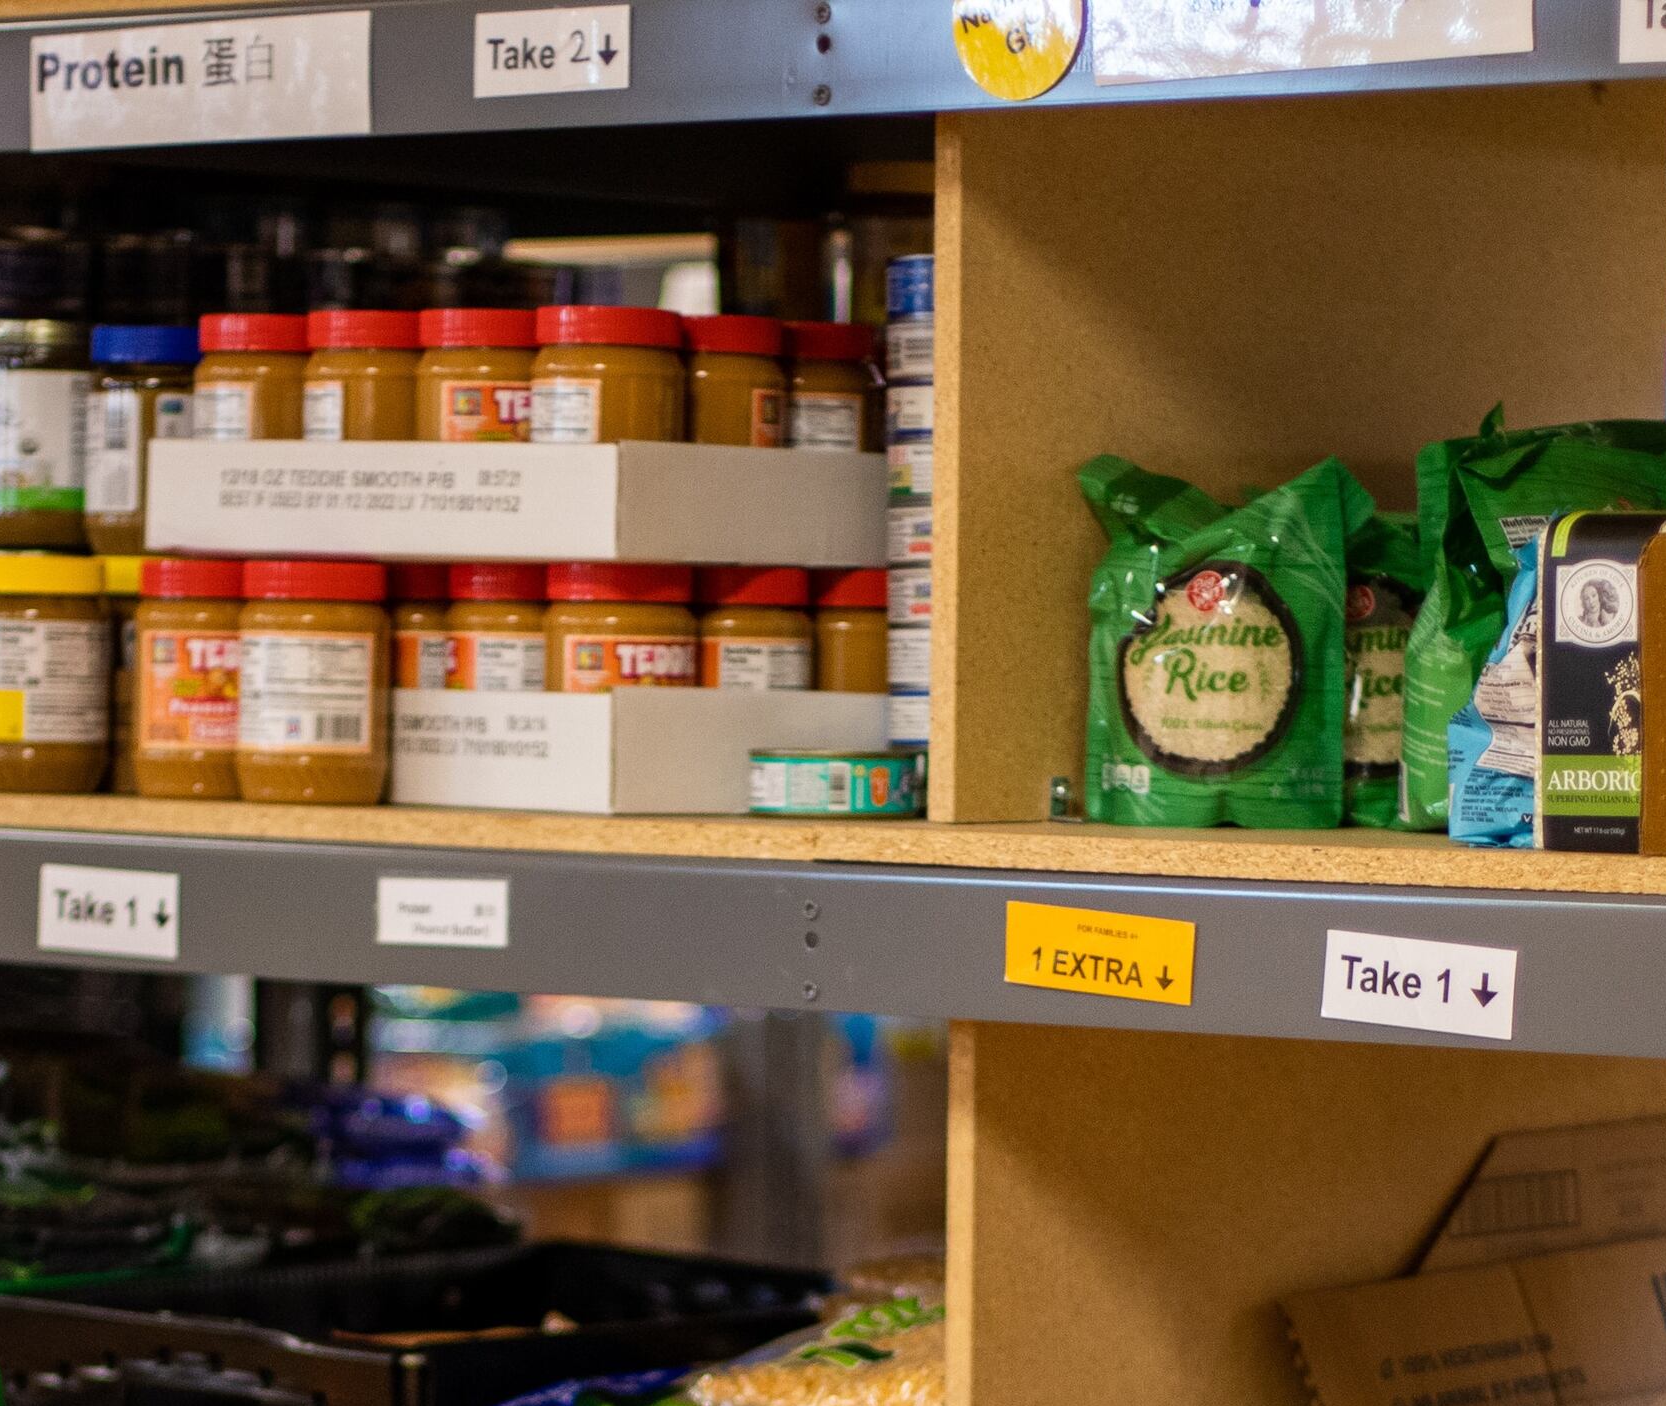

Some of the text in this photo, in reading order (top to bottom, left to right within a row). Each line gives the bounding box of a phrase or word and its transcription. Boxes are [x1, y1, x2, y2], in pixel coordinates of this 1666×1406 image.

[37, 38, 276, 92] Protein 蛋白
[487, 31, 590, 71] Take 2
[289, 468, 346, 488] TEDDIE
[351, 468, 423, 489] SMOOTH
[1130, 612, 1283, 666] Jasmine
[1163, 649, 1250, 702] Rice
[1548, 719, 1589, 728] ALL NATURAL
[1548, 736, 1590, 747] NON GMO
[55, 889, 137, 928] Take 1
[1033, 946, 1143, 988] 1 EXTRA
[1340, 954, 1451, 1004] Take 1
